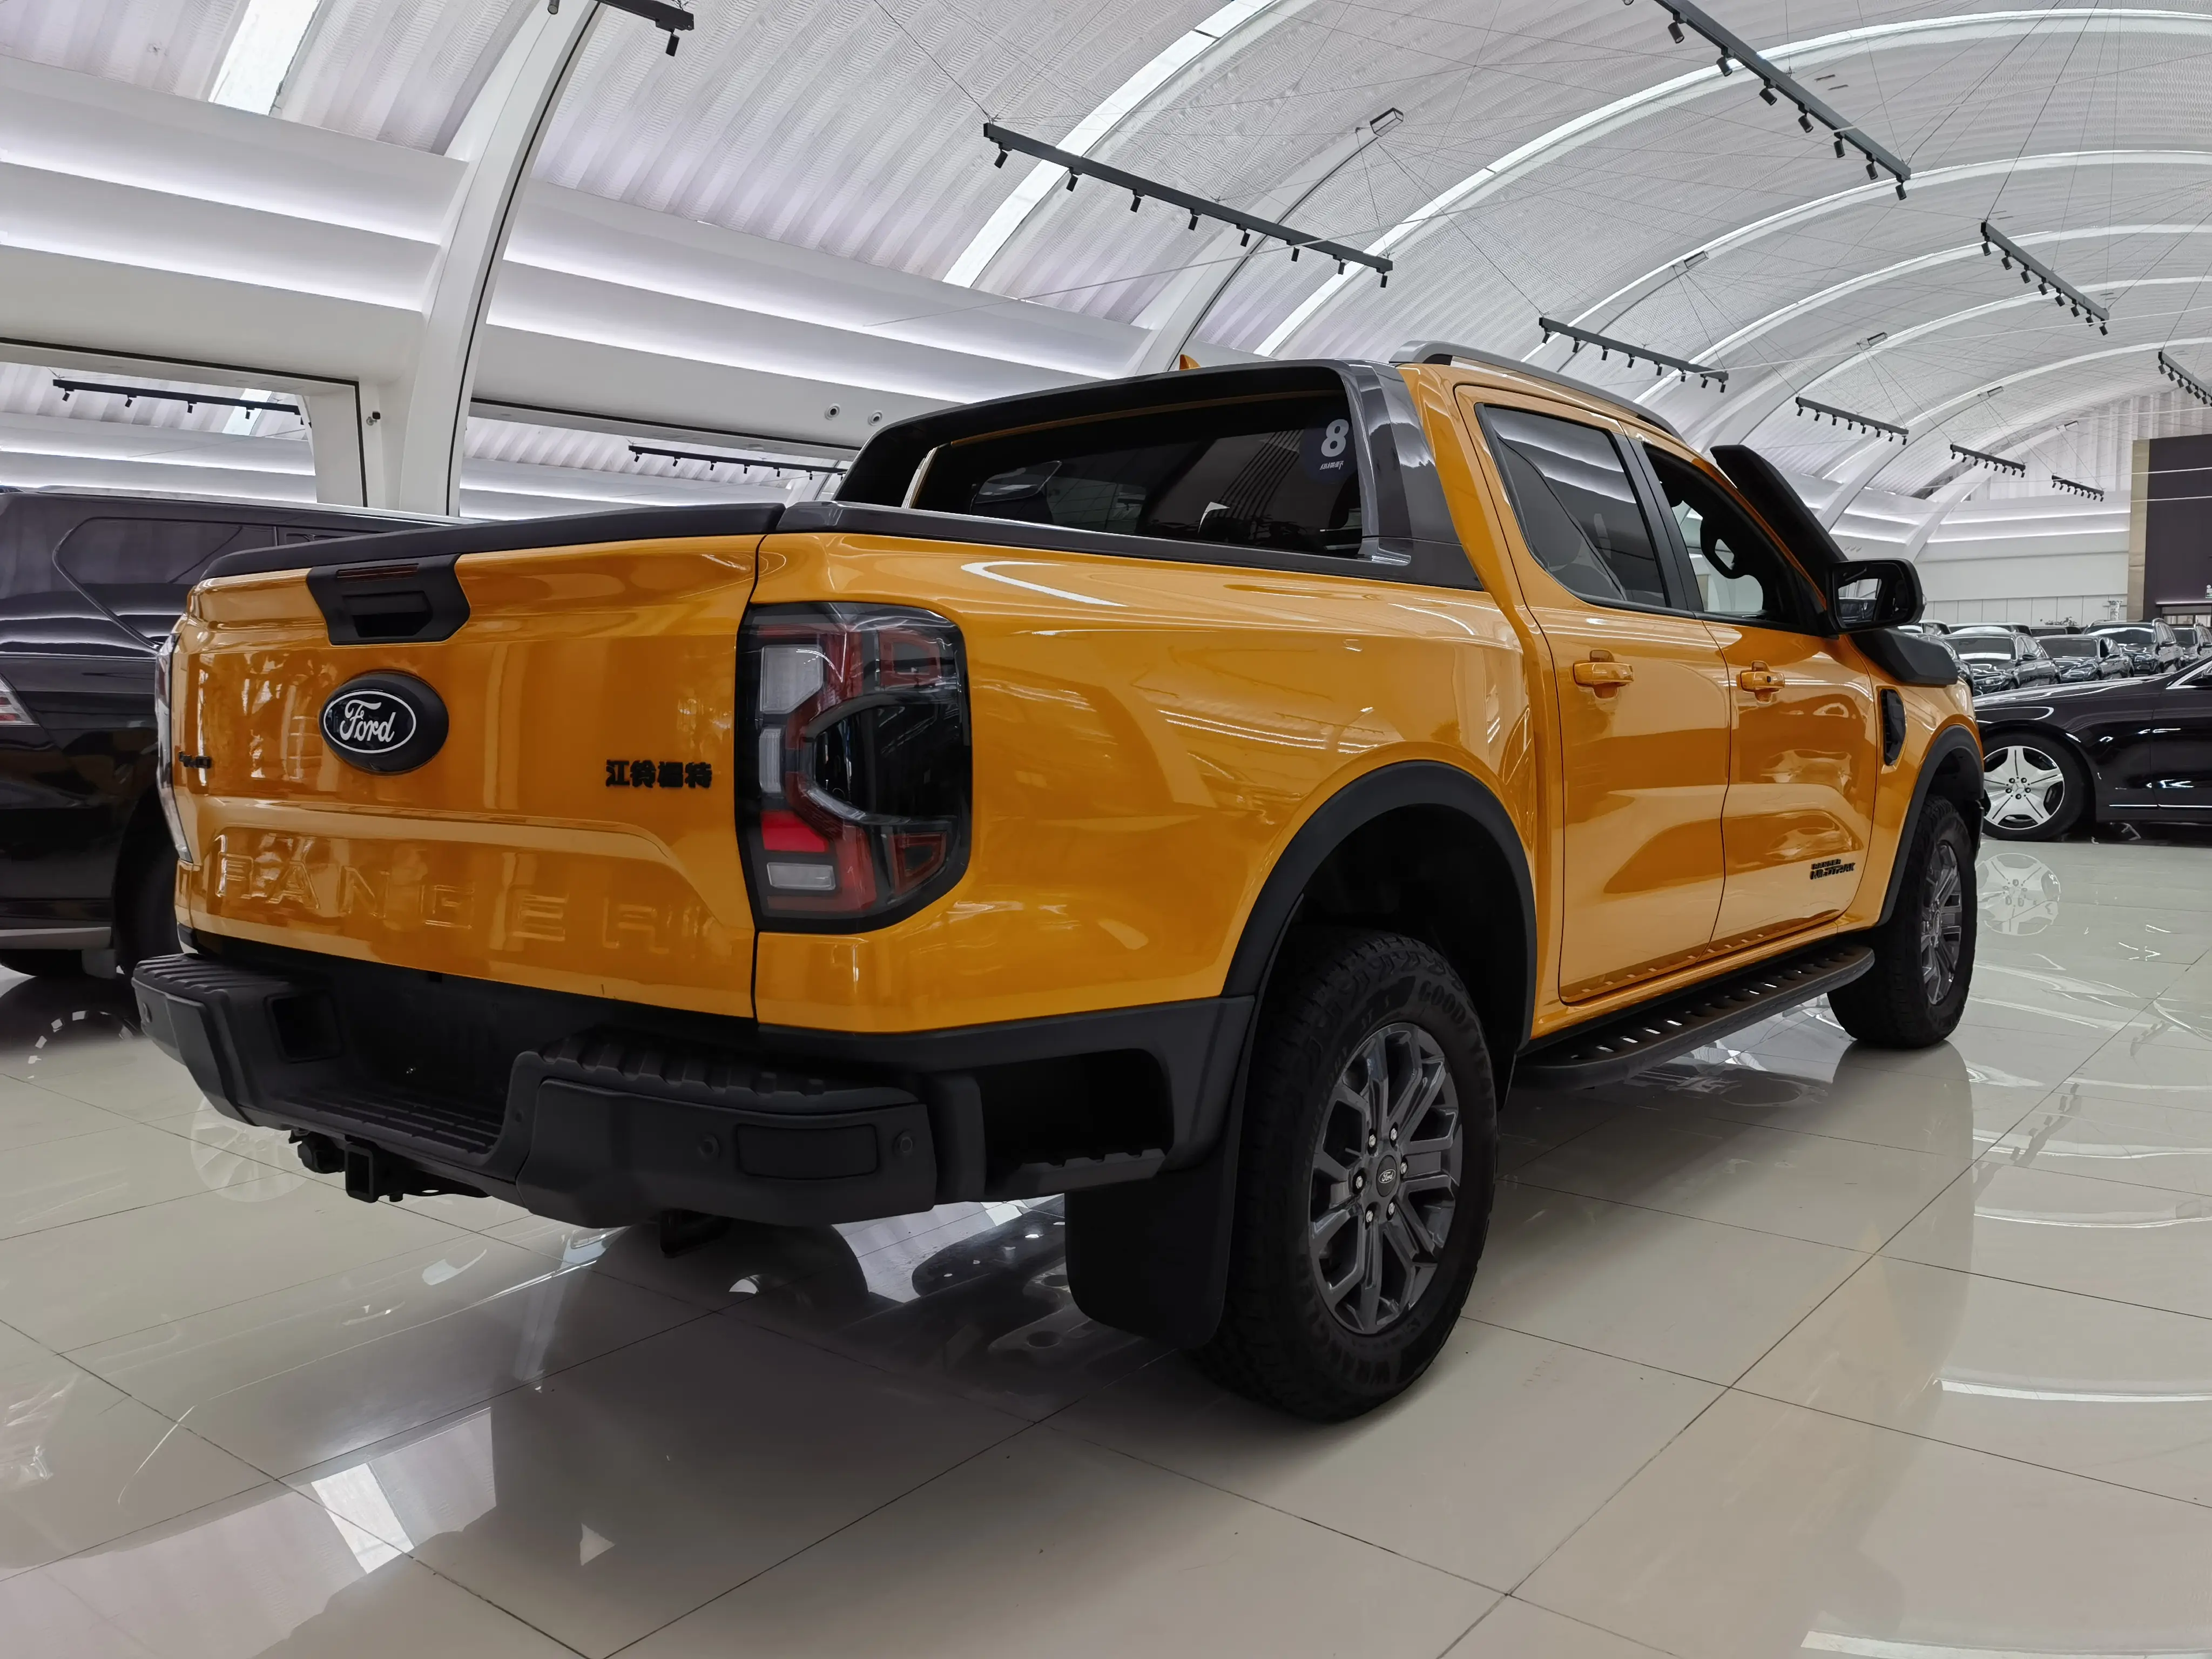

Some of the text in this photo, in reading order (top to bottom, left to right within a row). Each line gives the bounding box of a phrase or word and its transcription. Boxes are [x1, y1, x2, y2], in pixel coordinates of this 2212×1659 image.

[1321, 419, 1350, 457] 8
[339, 699, 397, 743] Ford
[605, 759, 712, 788] 江铃福特
[215, 851, 670, 954] RANGER
